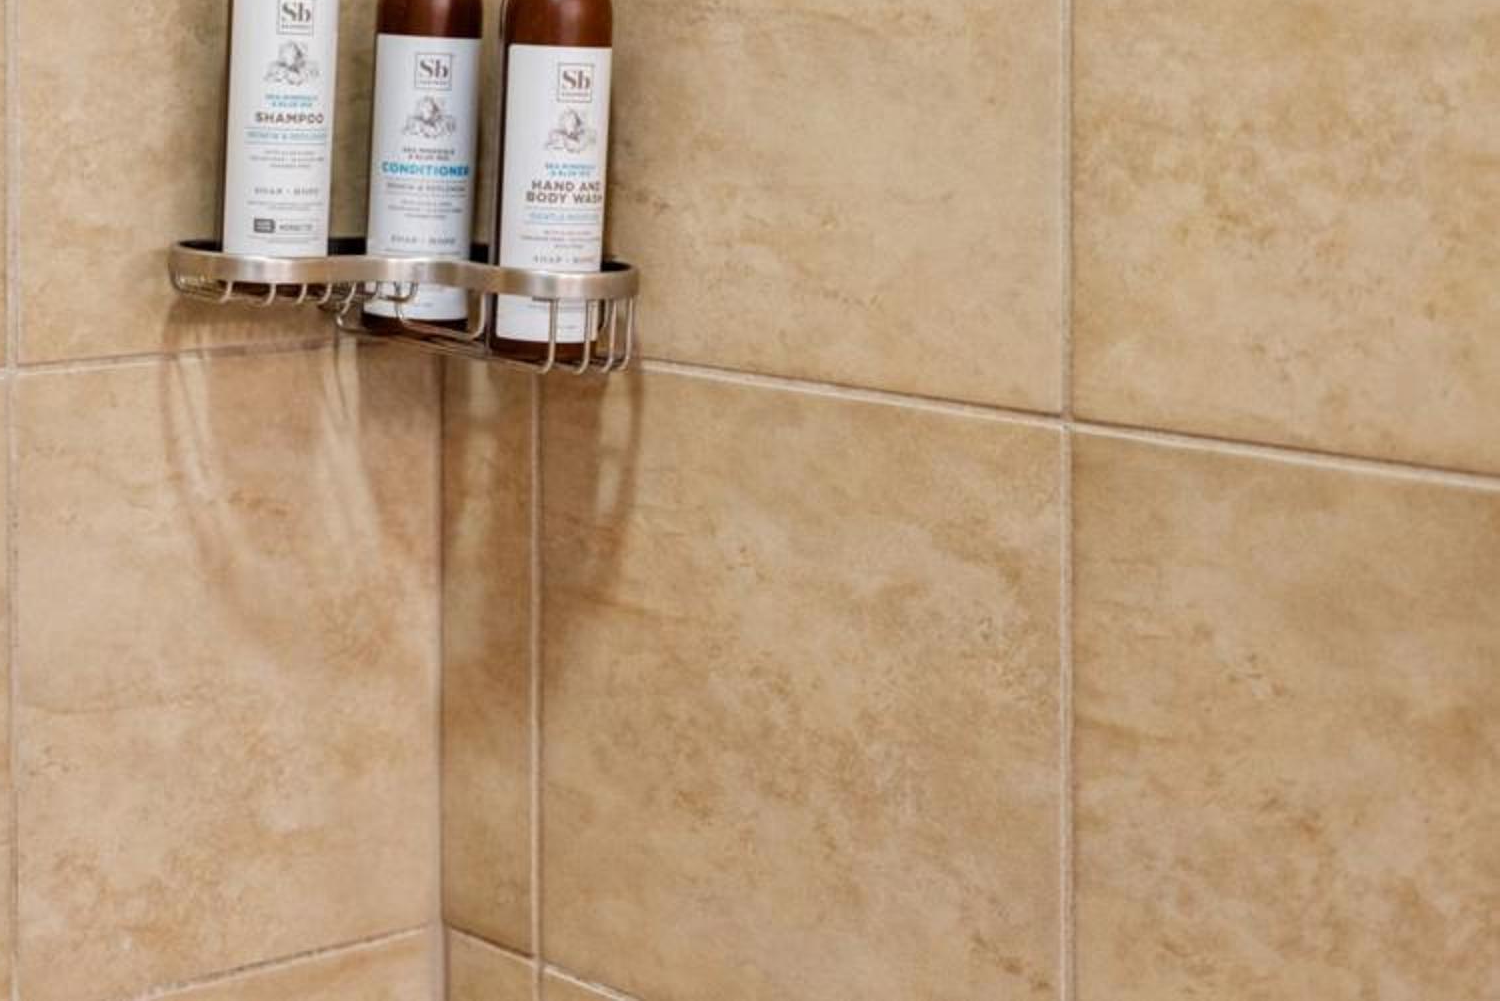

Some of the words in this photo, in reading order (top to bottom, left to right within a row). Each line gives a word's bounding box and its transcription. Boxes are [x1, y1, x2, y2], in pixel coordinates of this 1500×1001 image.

[281, 1, 312, 22] Sb
[419, 59, 449, 79] Sb
[562, 70, 591, 90] Sb
[255, 110, 325, 125] SHAMPOO
[381, 160, 469, 177] CONDITIONER
[531, 179, 576, 193] HAND
[525, 190, 568, 205] BODY
